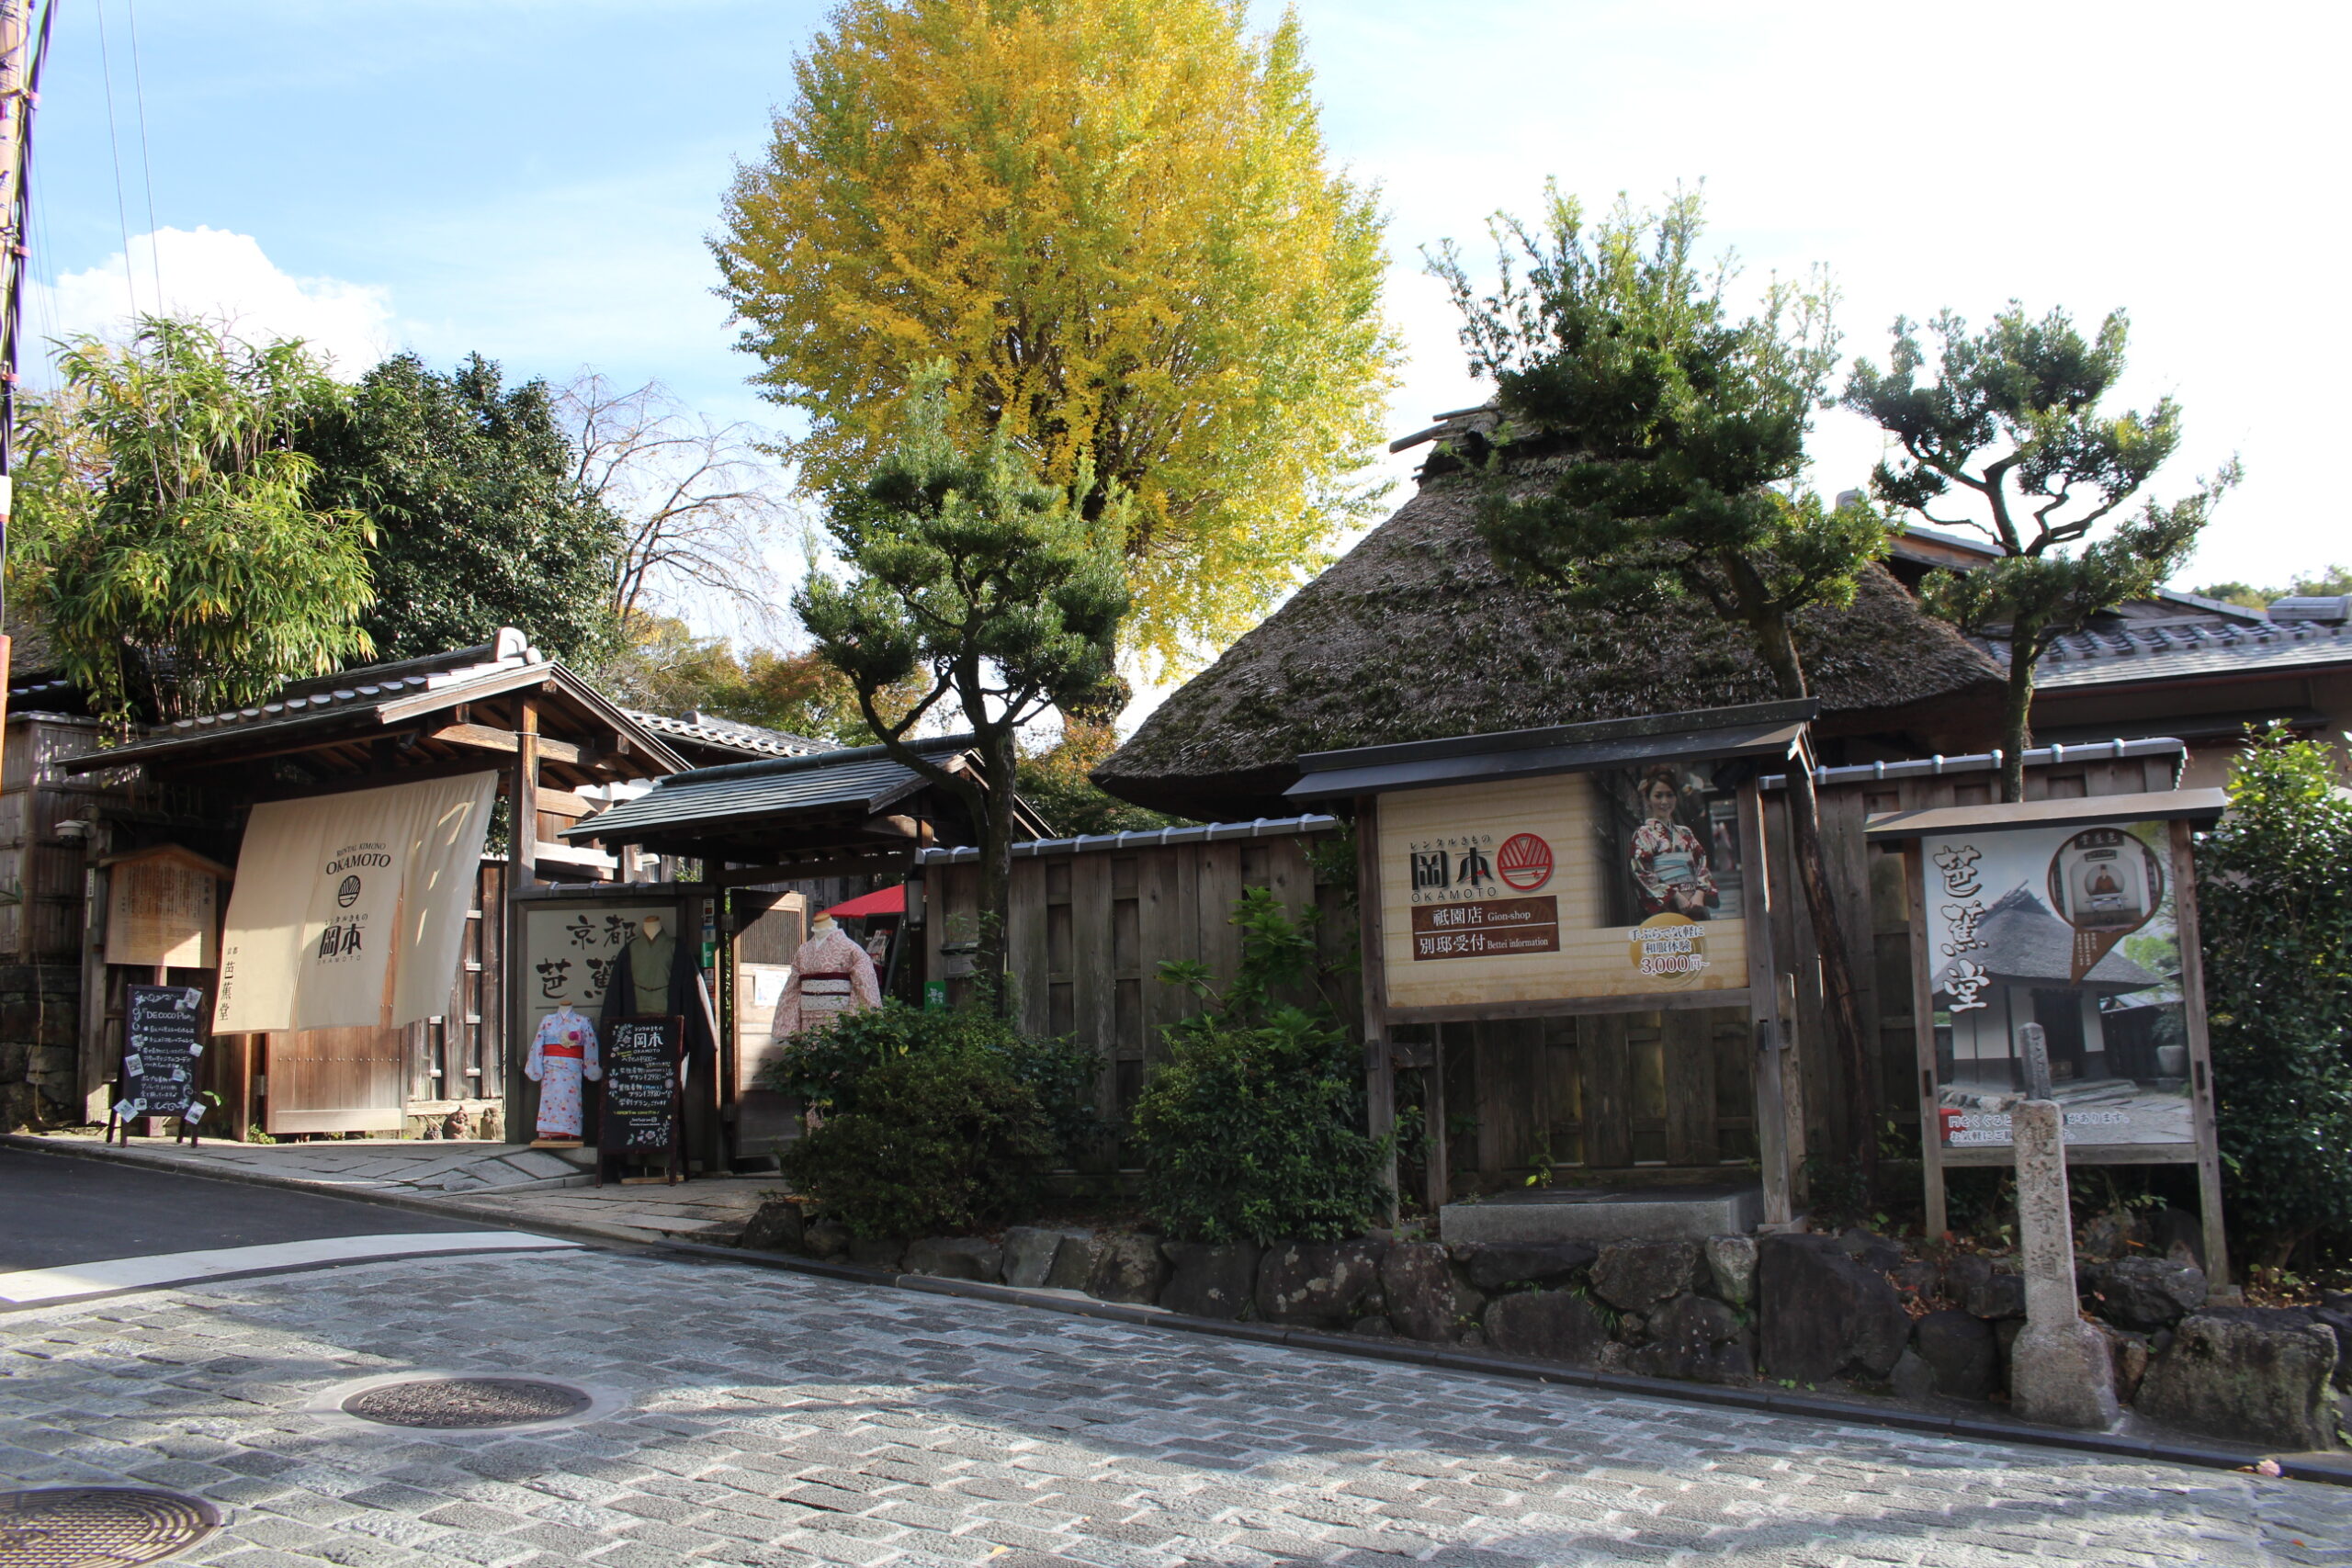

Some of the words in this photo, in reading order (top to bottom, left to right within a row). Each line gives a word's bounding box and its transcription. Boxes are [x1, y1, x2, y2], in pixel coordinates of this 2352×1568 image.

[358, 842, 387, 851] KIMONO
[1409, 834, 1491, 850] レンタルきもの
[326, 853, 391, 874] OKAMOTO
[1410, 847, 1493, 890] 岡本
[1411, 887, 1497, 903] OKAMOTO
[1487, 910, 1531, 922] Gion-shop
[566, 914, 639, 950] 京都
[1932, 845, 1990, 1013] 芭蕉堂
[318, 923, 366, 958] 岡本
[1419, 933, 1485, 955] 別邸受付
[1487, 940, 1508, 949] Bettei
[1510, 937, 1549, 948] information
[317, 955, 361, 965] OKAMOTO
[219, 961, 236, 1021] 芭蕉堂
[634, 1032, 663, 1048] 岡本
